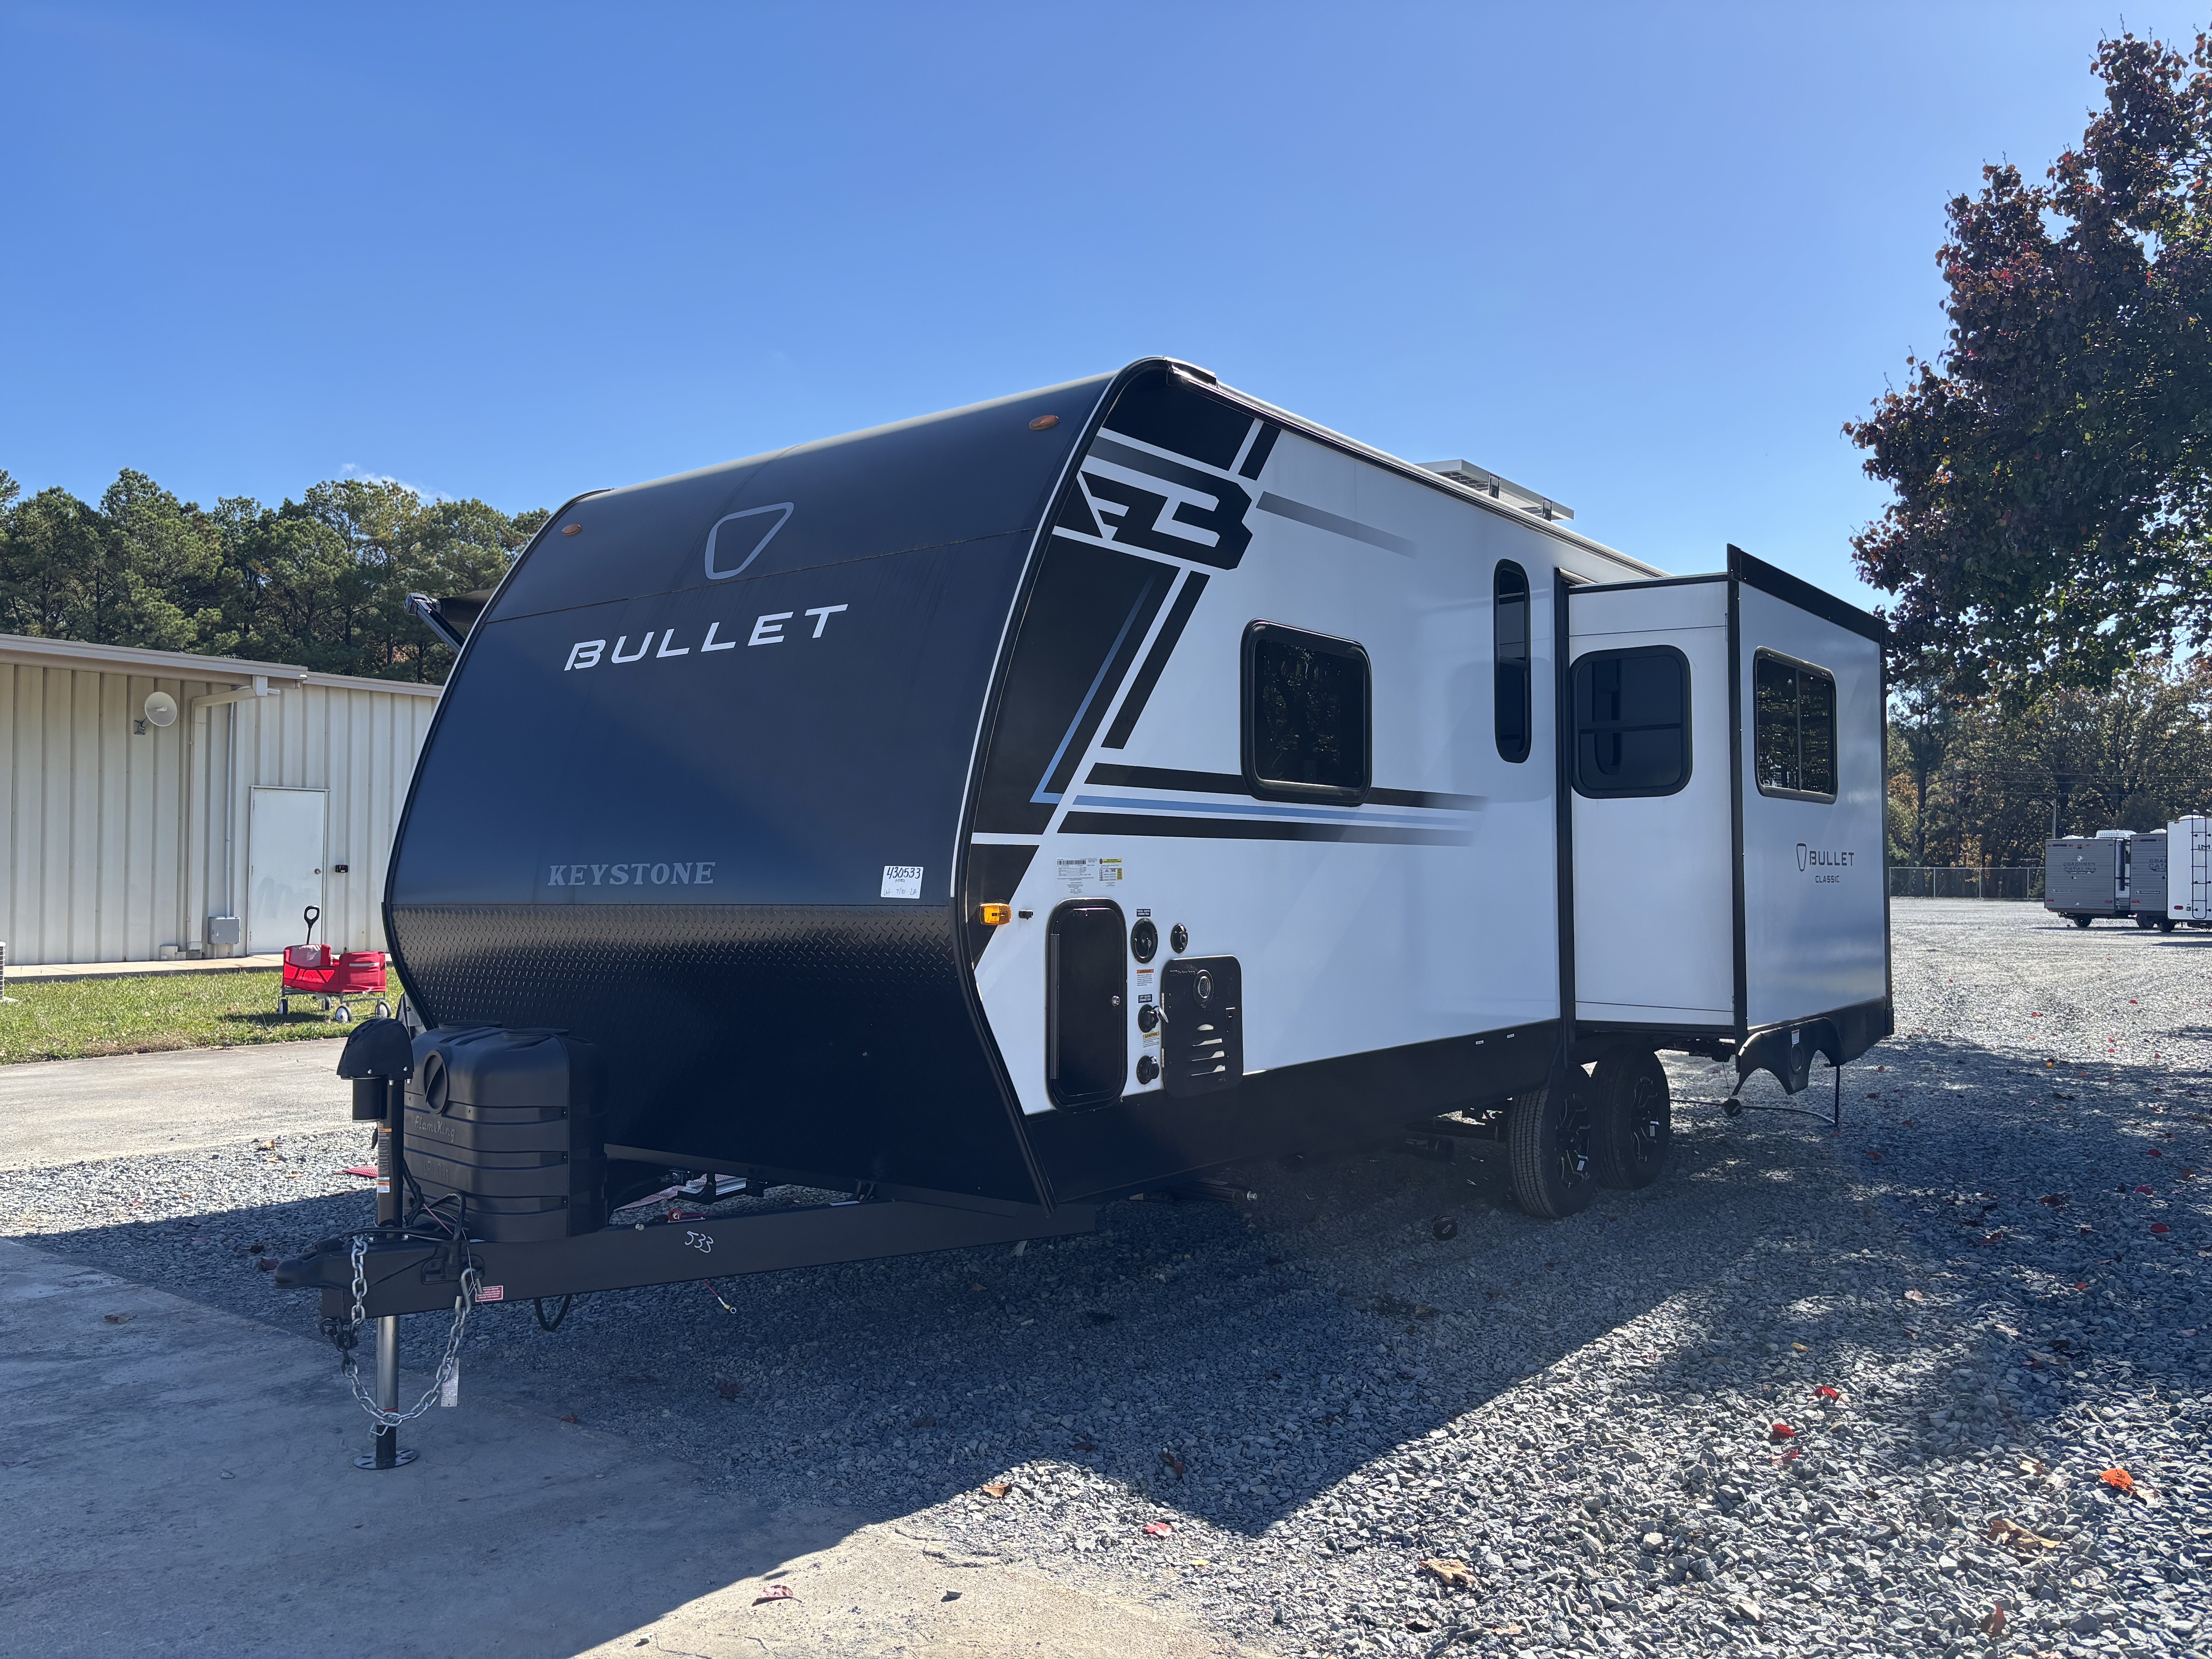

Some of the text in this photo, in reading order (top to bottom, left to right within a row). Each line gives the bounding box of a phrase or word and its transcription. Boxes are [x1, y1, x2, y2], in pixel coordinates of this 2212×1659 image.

[564, 604, 848, 671] BULLET
[1810, 851, 1854, 866] BULLET
[548, 862, 715, 886] KEYSTONE
[887, 867, 921, 879] 430533
[685, 1231, 714, 1253] 533
